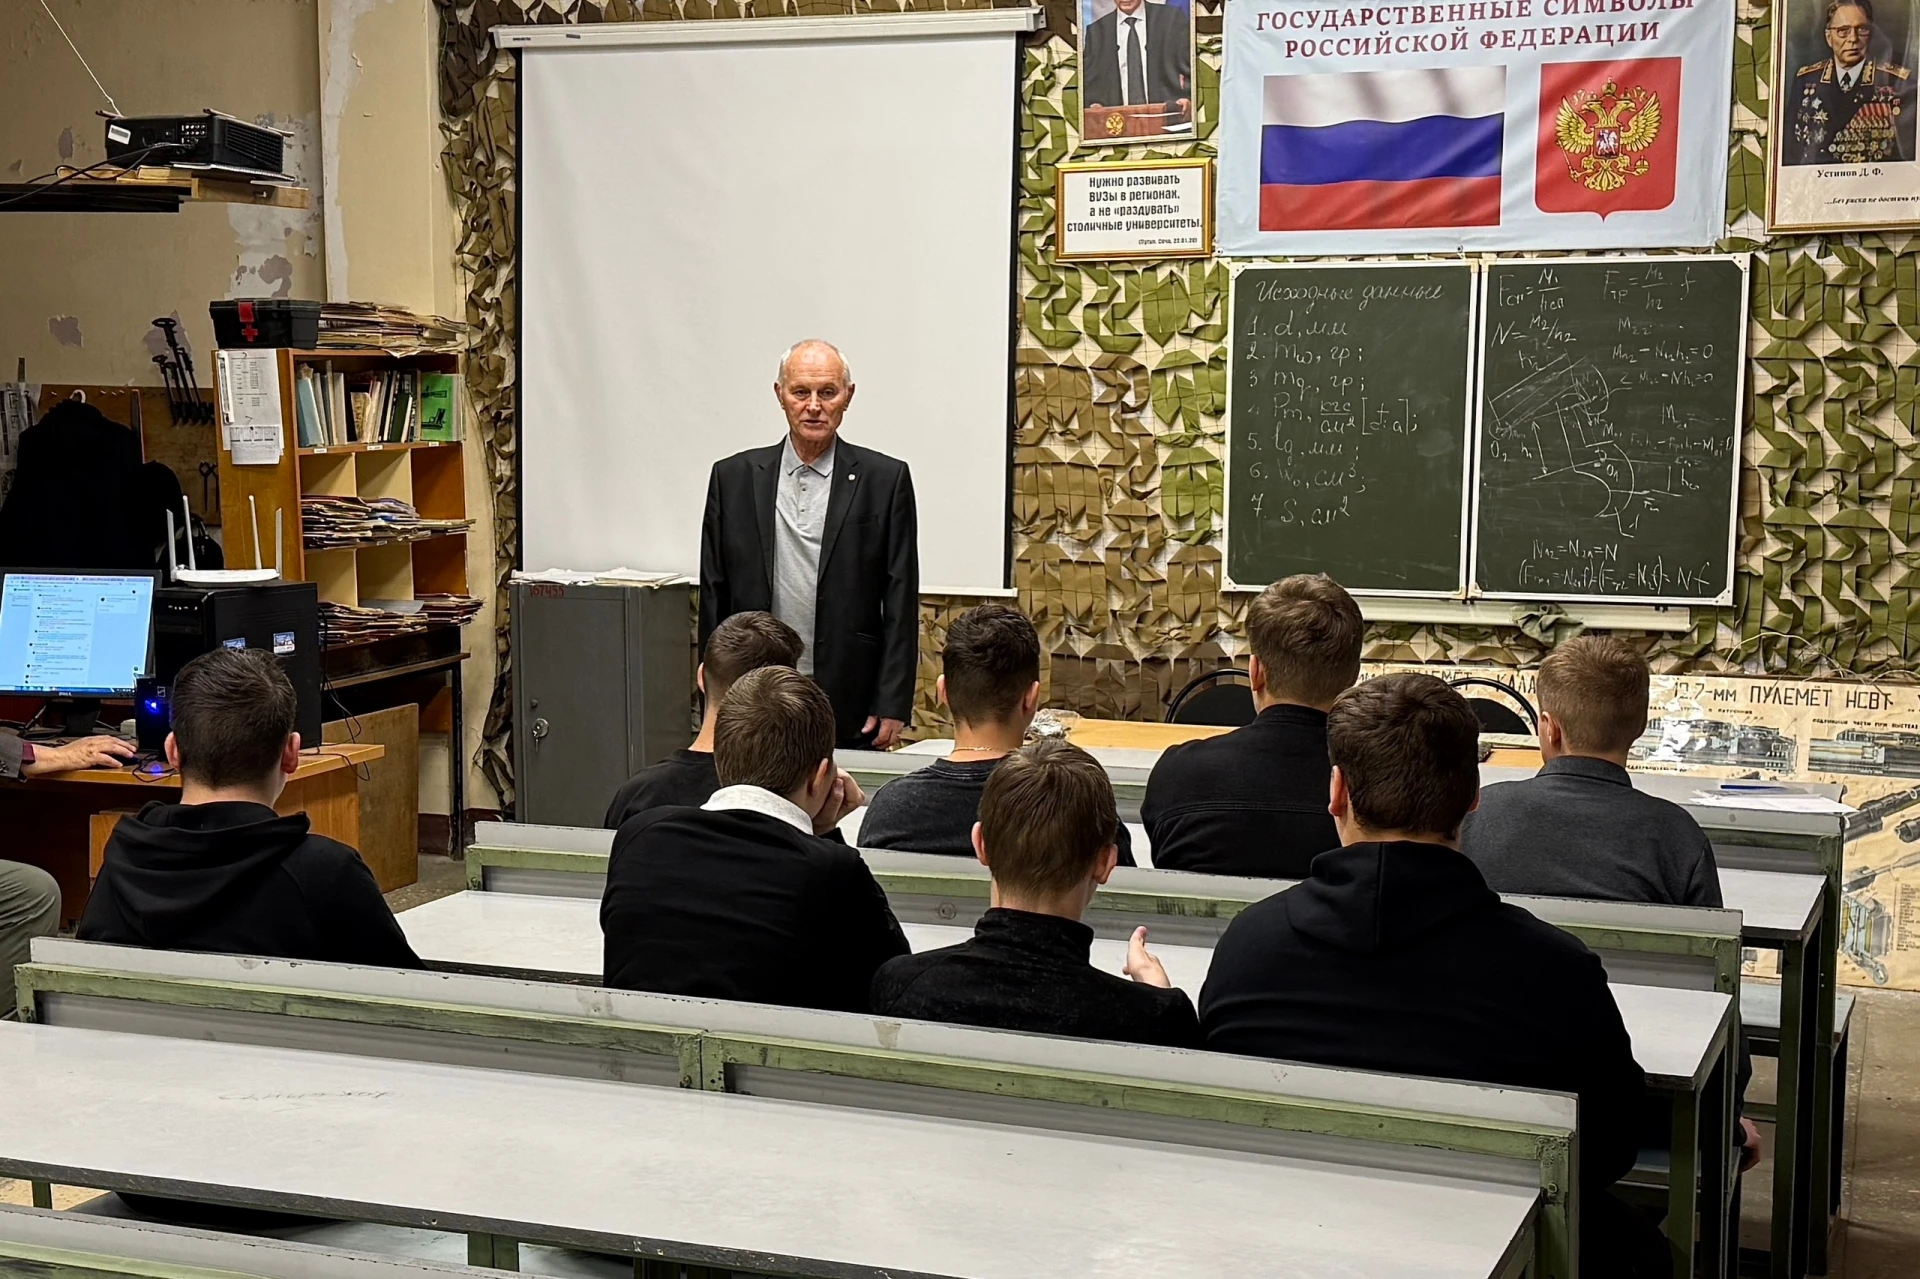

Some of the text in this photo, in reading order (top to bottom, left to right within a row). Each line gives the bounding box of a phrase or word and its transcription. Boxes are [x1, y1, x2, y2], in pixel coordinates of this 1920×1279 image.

[1256, 0, 1532, 32] ГОСУДАРСТВЕННЫЕ
[1285, 22, 1660, 58] РОССИЙСКОЙ ФЕДЕРАЦИИ
[1090, 175, 1180, 188] Нужно развивать
[1817, 169, 1857, 178] Устинов
[1872, 168, 1883, 176] Ф.
[1090, 191, 1117, 202] ВУЗы
[1121, 192, 1126, 200] в
[1090, 204, 1179, 216] а не «раздувать»
[1067, 218, 1202, 232] столичные университеты.
[1256, 280, 1443, 314] Исходные данные
[1248, 433, 1262, 451] 5.
[1249, 462, 1268, 479] 6.
[1750, 685, 1832, 707] ПУЛЕМЁТ
[1846, 690, 1891, 711] НСВТ
